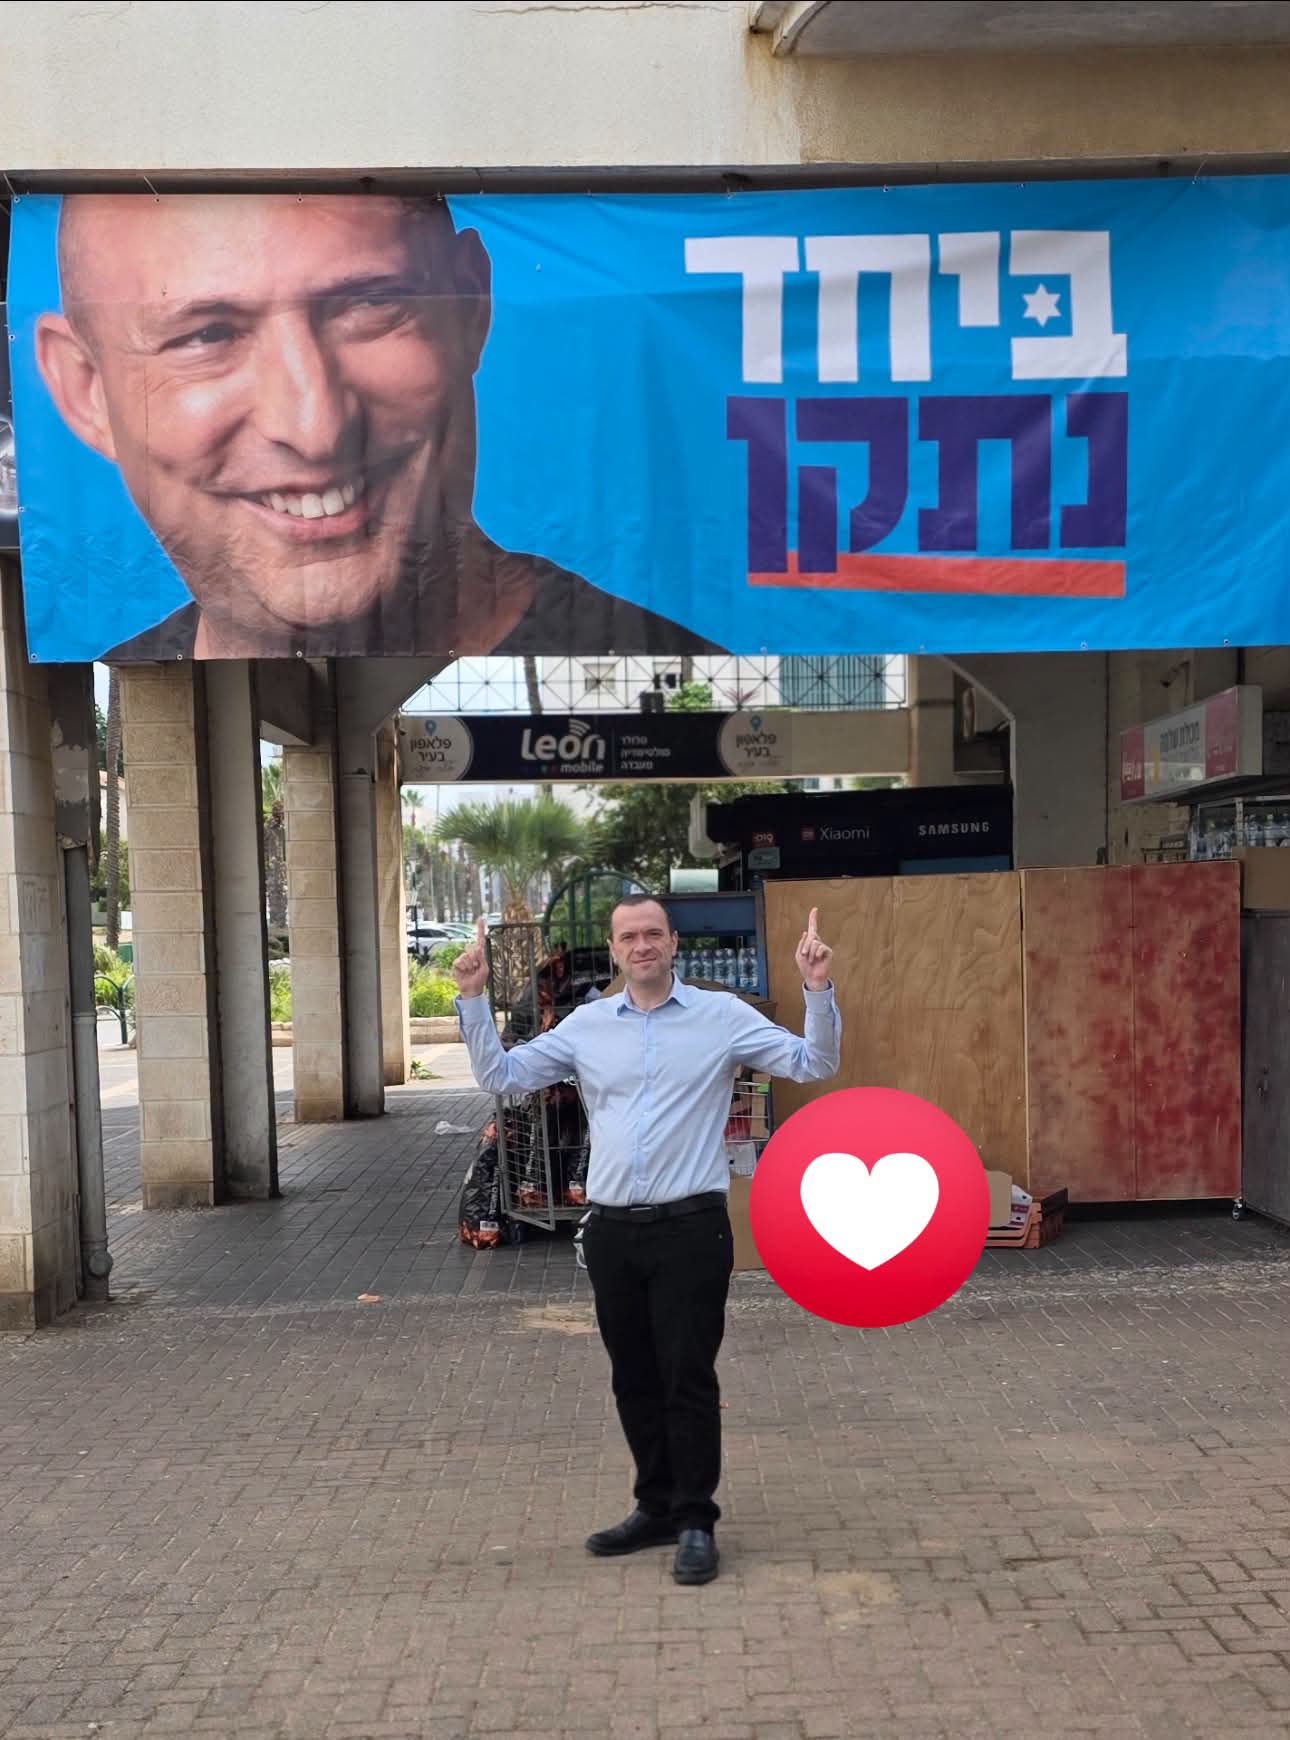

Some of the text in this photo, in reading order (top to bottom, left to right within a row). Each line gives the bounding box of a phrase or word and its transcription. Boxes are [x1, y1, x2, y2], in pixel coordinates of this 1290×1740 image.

[684, 229, 1128, 384] ביחד
[725, 391, 1129, 574] נתקן
[410, 735, 452, 753] פלאפון
[520, 728, 606, 761] Leon
[418, 751, 445, 762] בעיר
[560, 760, 605, 773] mobile
[819, 825, 871, 841] Xiaomi
[918, 821, 990, 837] SAMSUNG
